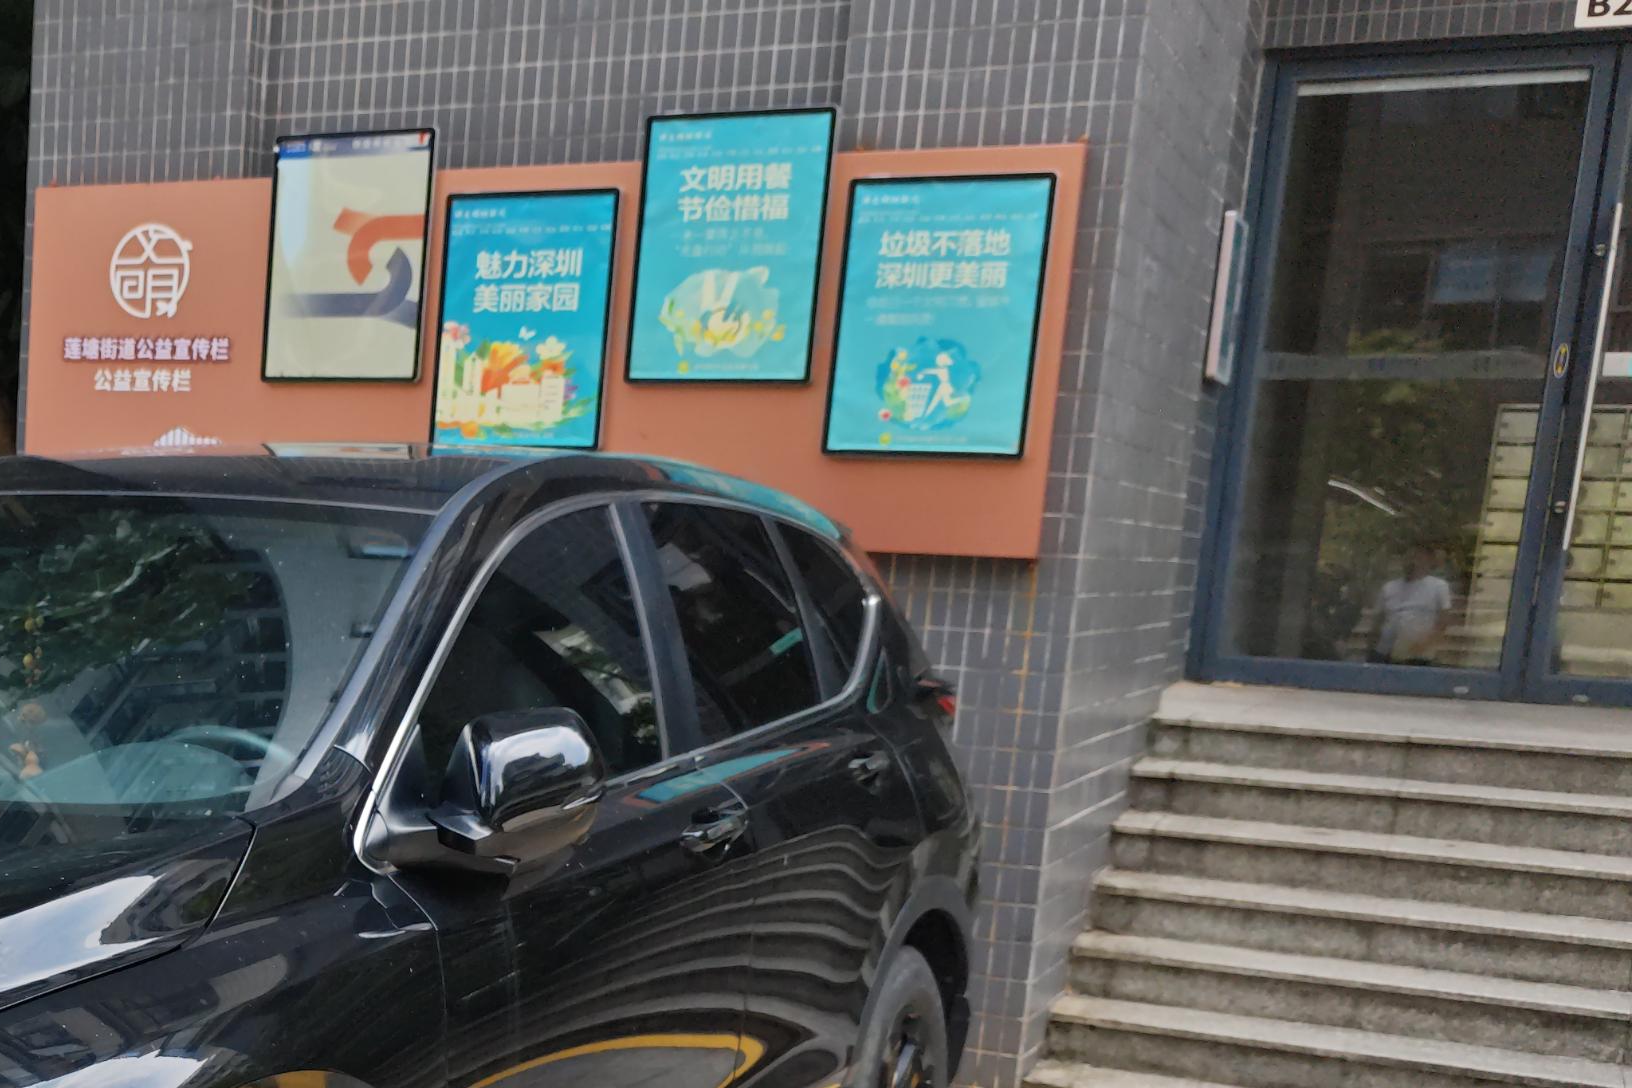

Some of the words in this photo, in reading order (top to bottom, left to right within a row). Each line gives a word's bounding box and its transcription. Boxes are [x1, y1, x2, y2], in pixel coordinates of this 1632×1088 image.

[680, 164, 792, 192] 文明用餐
[678, 194, 790, 222] 节俭惜福
[879, 230, 1011, 256] 垃圾不落地
[475, 249, 583, 280] 魅力深圳
[876, 262, 1009, 288] 深圳更美丽
[473, 284, 580, 313] 美丽家园
[64, 337, 229, 360] 莲塘街道公益宣传栏
[94, 370, 192, 392] 公益宣传栏
